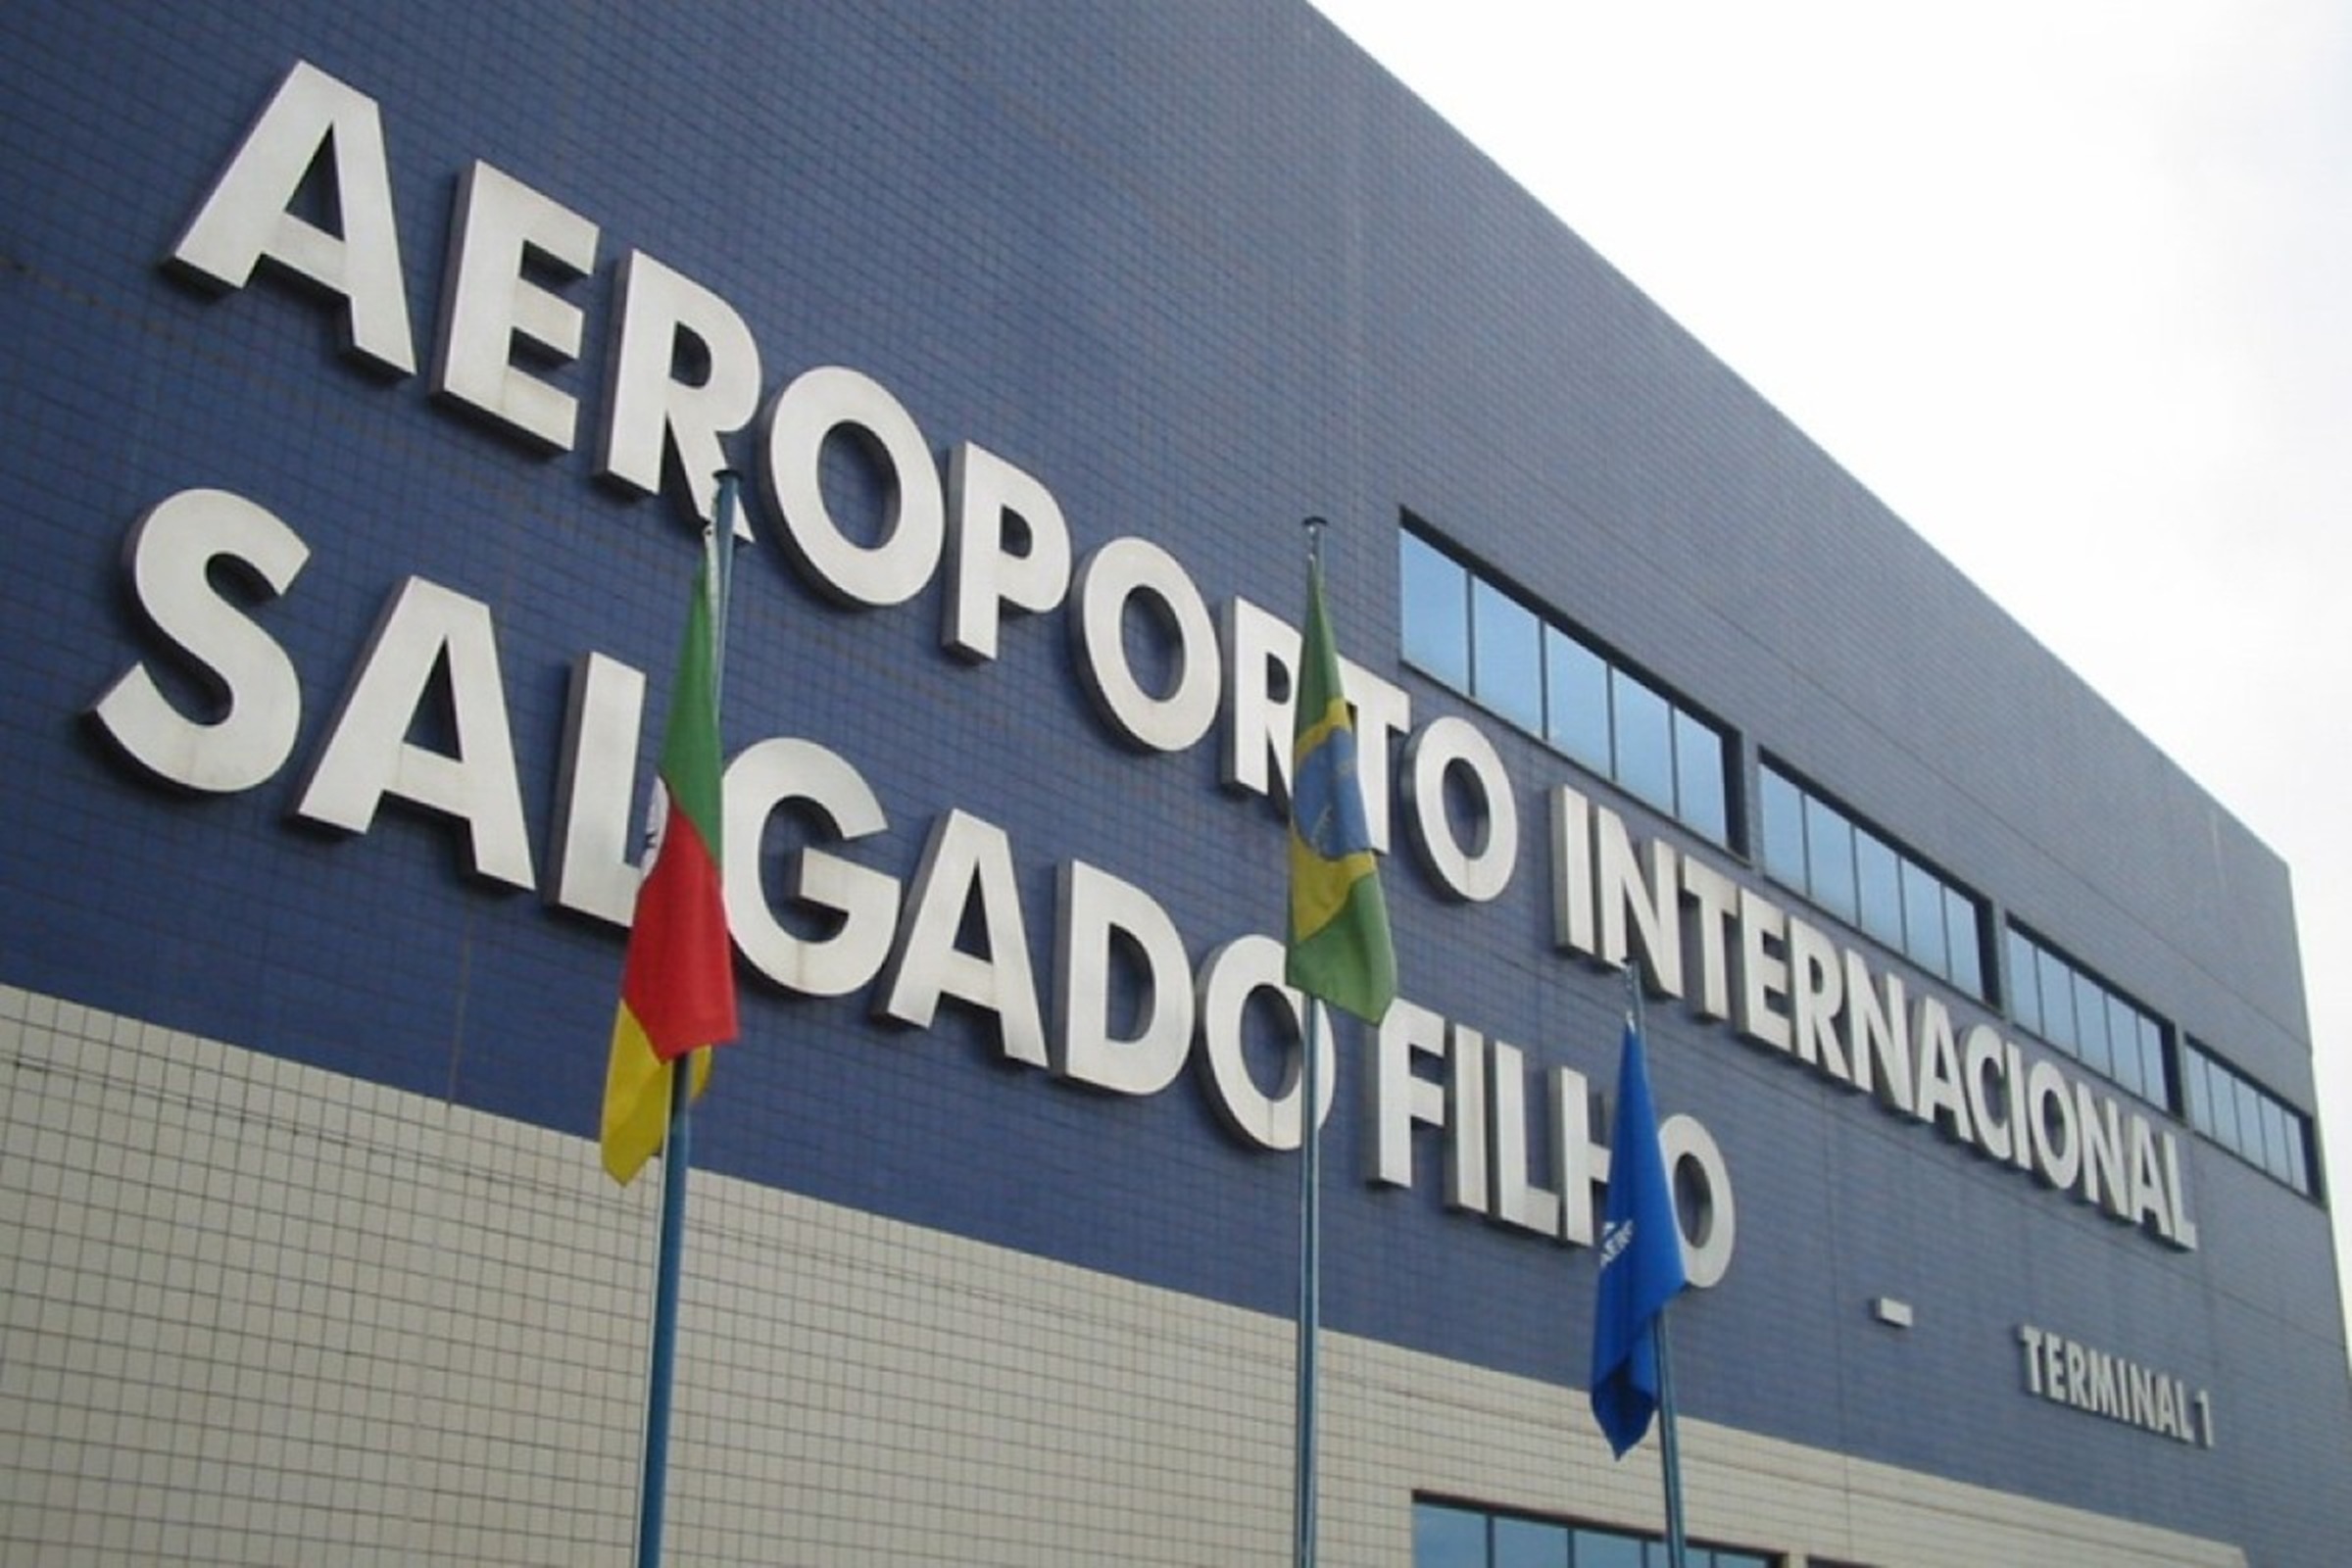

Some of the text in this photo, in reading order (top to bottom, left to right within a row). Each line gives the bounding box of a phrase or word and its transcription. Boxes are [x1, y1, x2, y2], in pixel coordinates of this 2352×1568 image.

[91, 488, 1336, 1151] SALGADO
[167, 59, 2197, 1250] AEROPORTO INTERNACIONAL
[2019, 1324, 2214, 1447] TERMINAL 1
